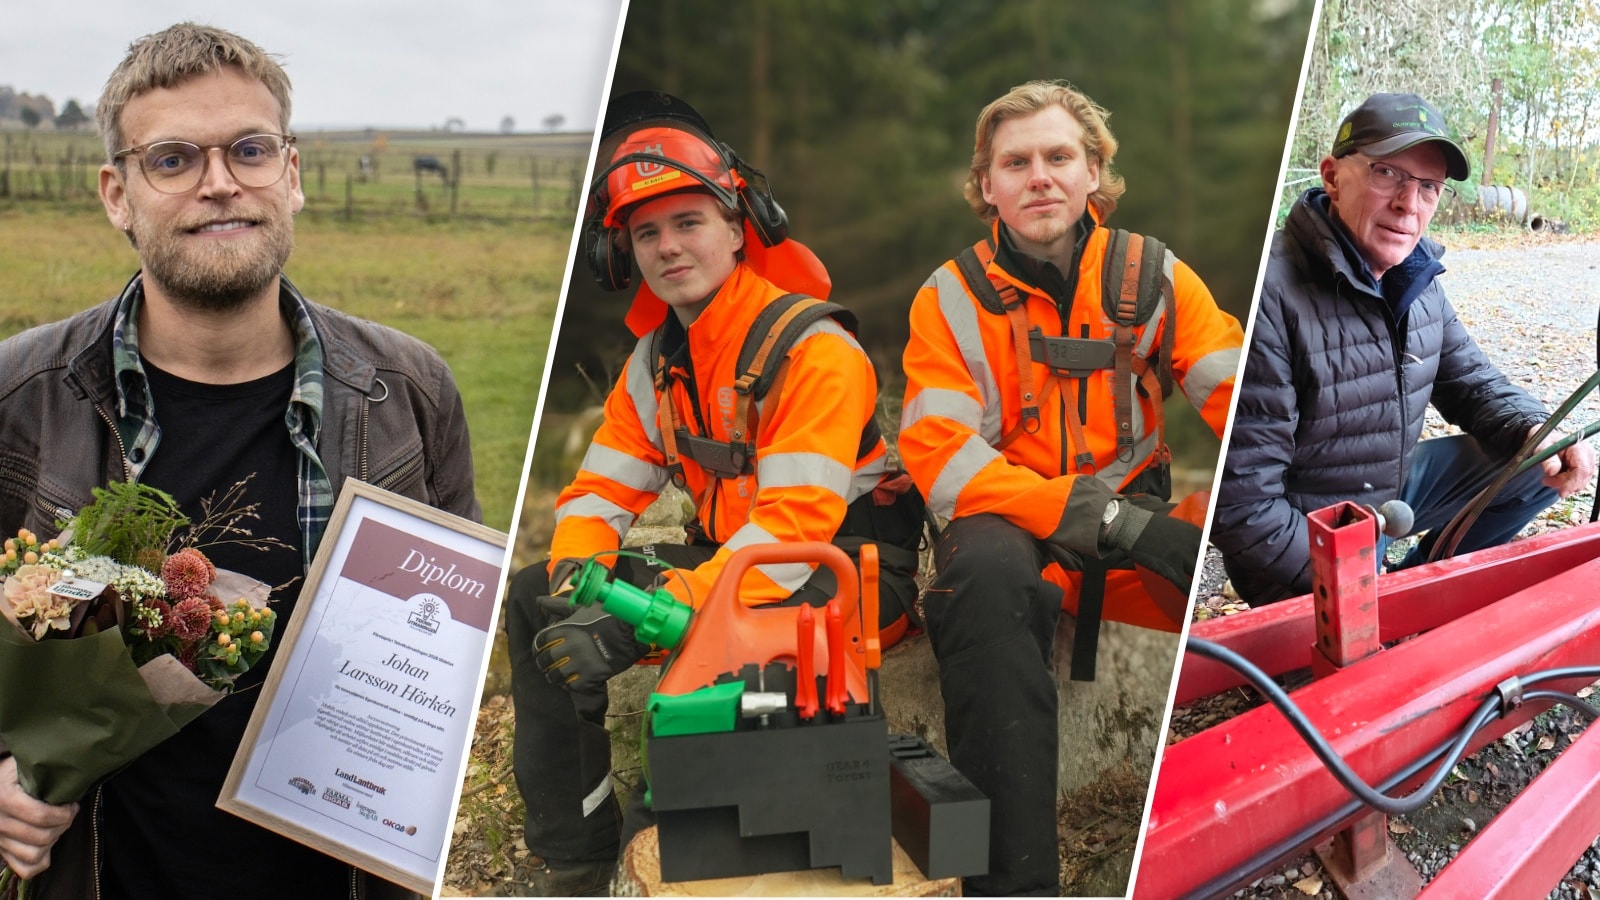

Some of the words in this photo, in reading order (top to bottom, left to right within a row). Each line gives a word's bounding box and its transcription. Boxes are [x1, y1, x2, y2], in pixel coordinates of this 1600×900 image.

[399, 550, 484, 598] Diplom
[338, 661, 398, 694] Larsson
[400, 685, 455, 717] Hörkén
[382, 654, 428, 680] Johan
